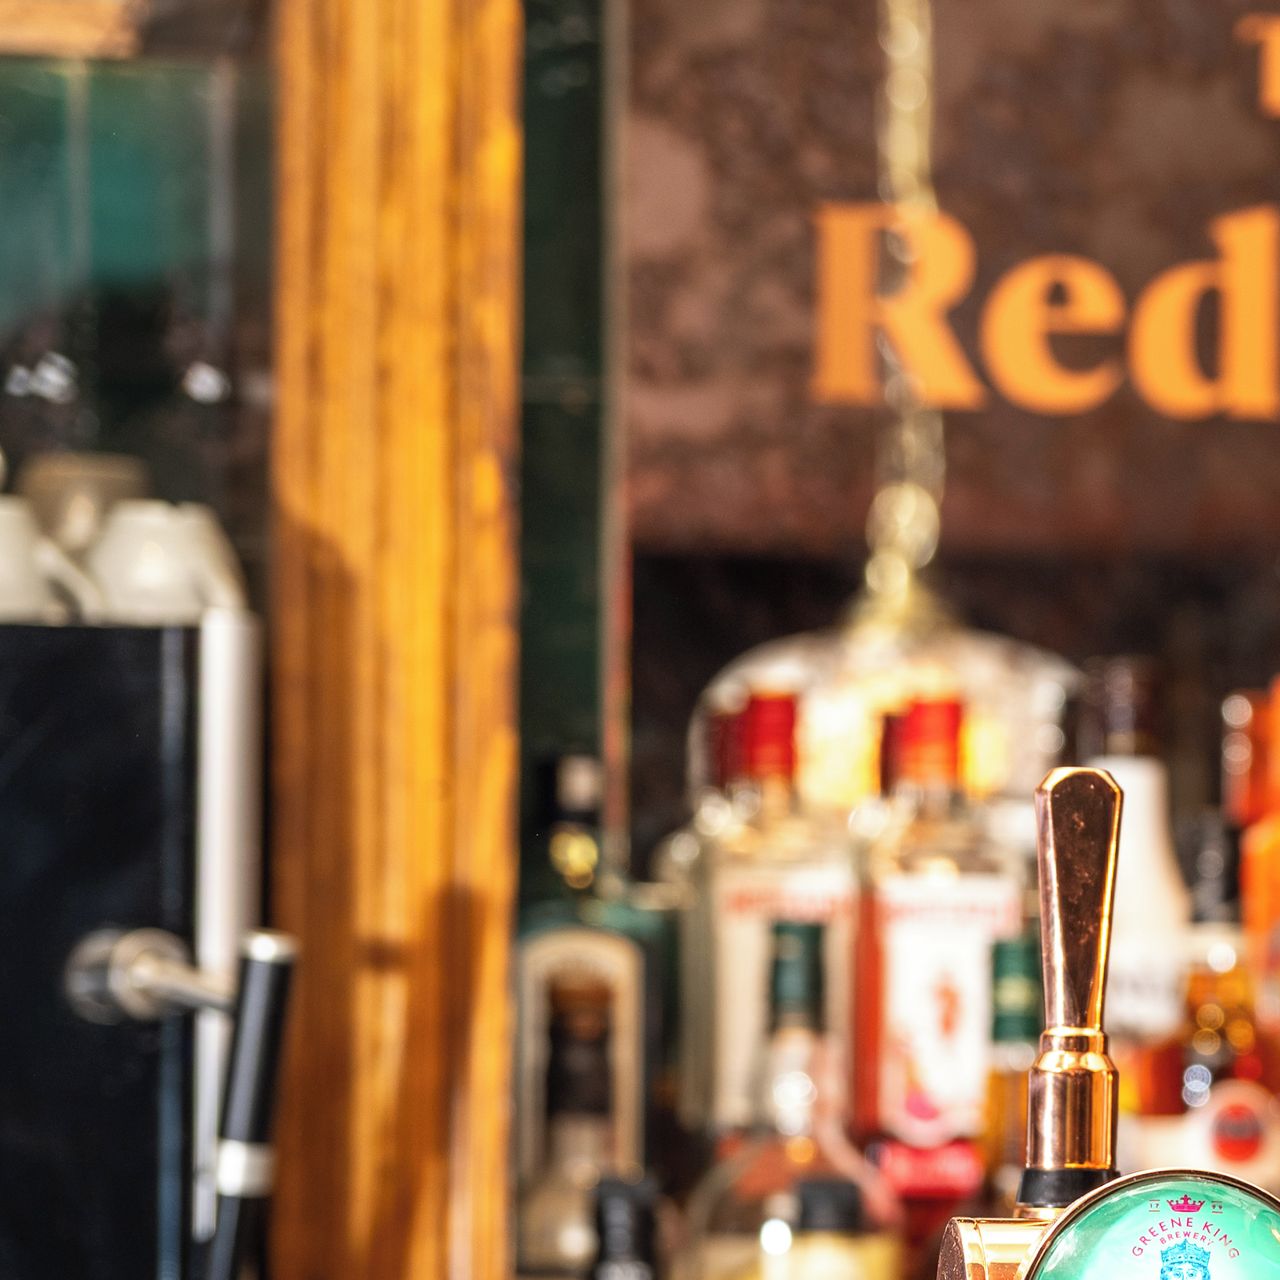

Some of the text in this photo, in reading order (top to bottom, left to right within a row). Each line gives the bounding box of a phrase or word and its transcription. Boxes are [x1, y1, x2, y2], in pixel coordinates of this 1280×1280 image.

[1132, 1217, 1240, 1259] GREENE KING
[1160, 1231, 1214, 1246] BREWERY
